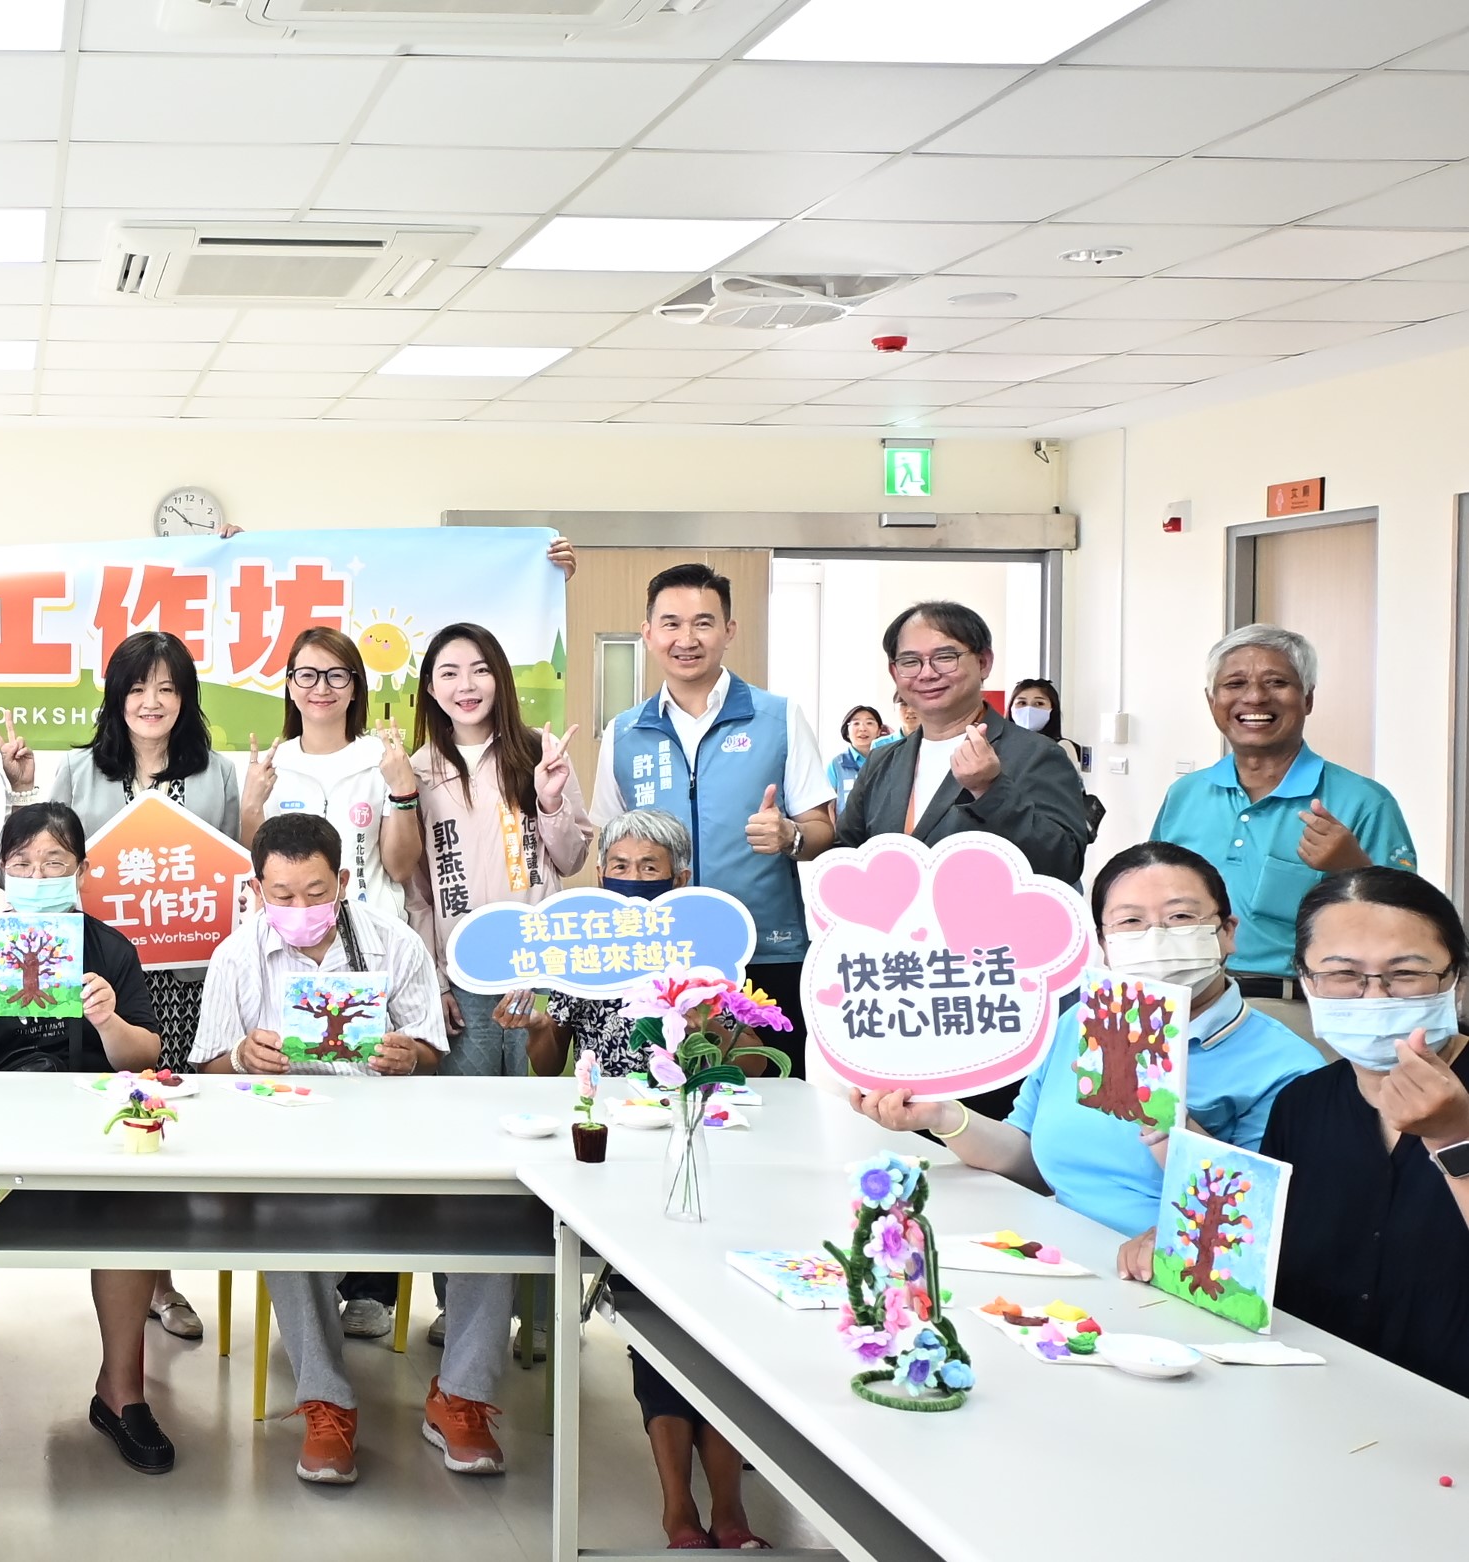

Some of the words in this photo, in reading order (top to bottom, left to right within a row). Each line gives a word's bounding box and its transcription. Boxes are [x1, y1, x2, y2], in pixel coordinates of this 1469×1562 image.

[164, 505, 174, 513] 10
[207, 507, 213, 515] 2
[633, 753, 656, 807] 許瑞
[117, 844, 195, 885] 樂活
[355, 833, 366, 889] 彰化縣議員
[432, 818, 472, 918] 郭燕陵
[520, 809, 543, 888] 化縣議員
[102, 885, 217, 927] 工作坊
[519, 906, 676, 943] 我正在變好
[129, 936, 147, 946] as
[150, 930, 221, 944] Workshop
[509, 940, 696, 977] 也會越來越好
[837, 946, 1016, 993] 快樂生活
[842, 993, 1021, 1039] 從心開始
